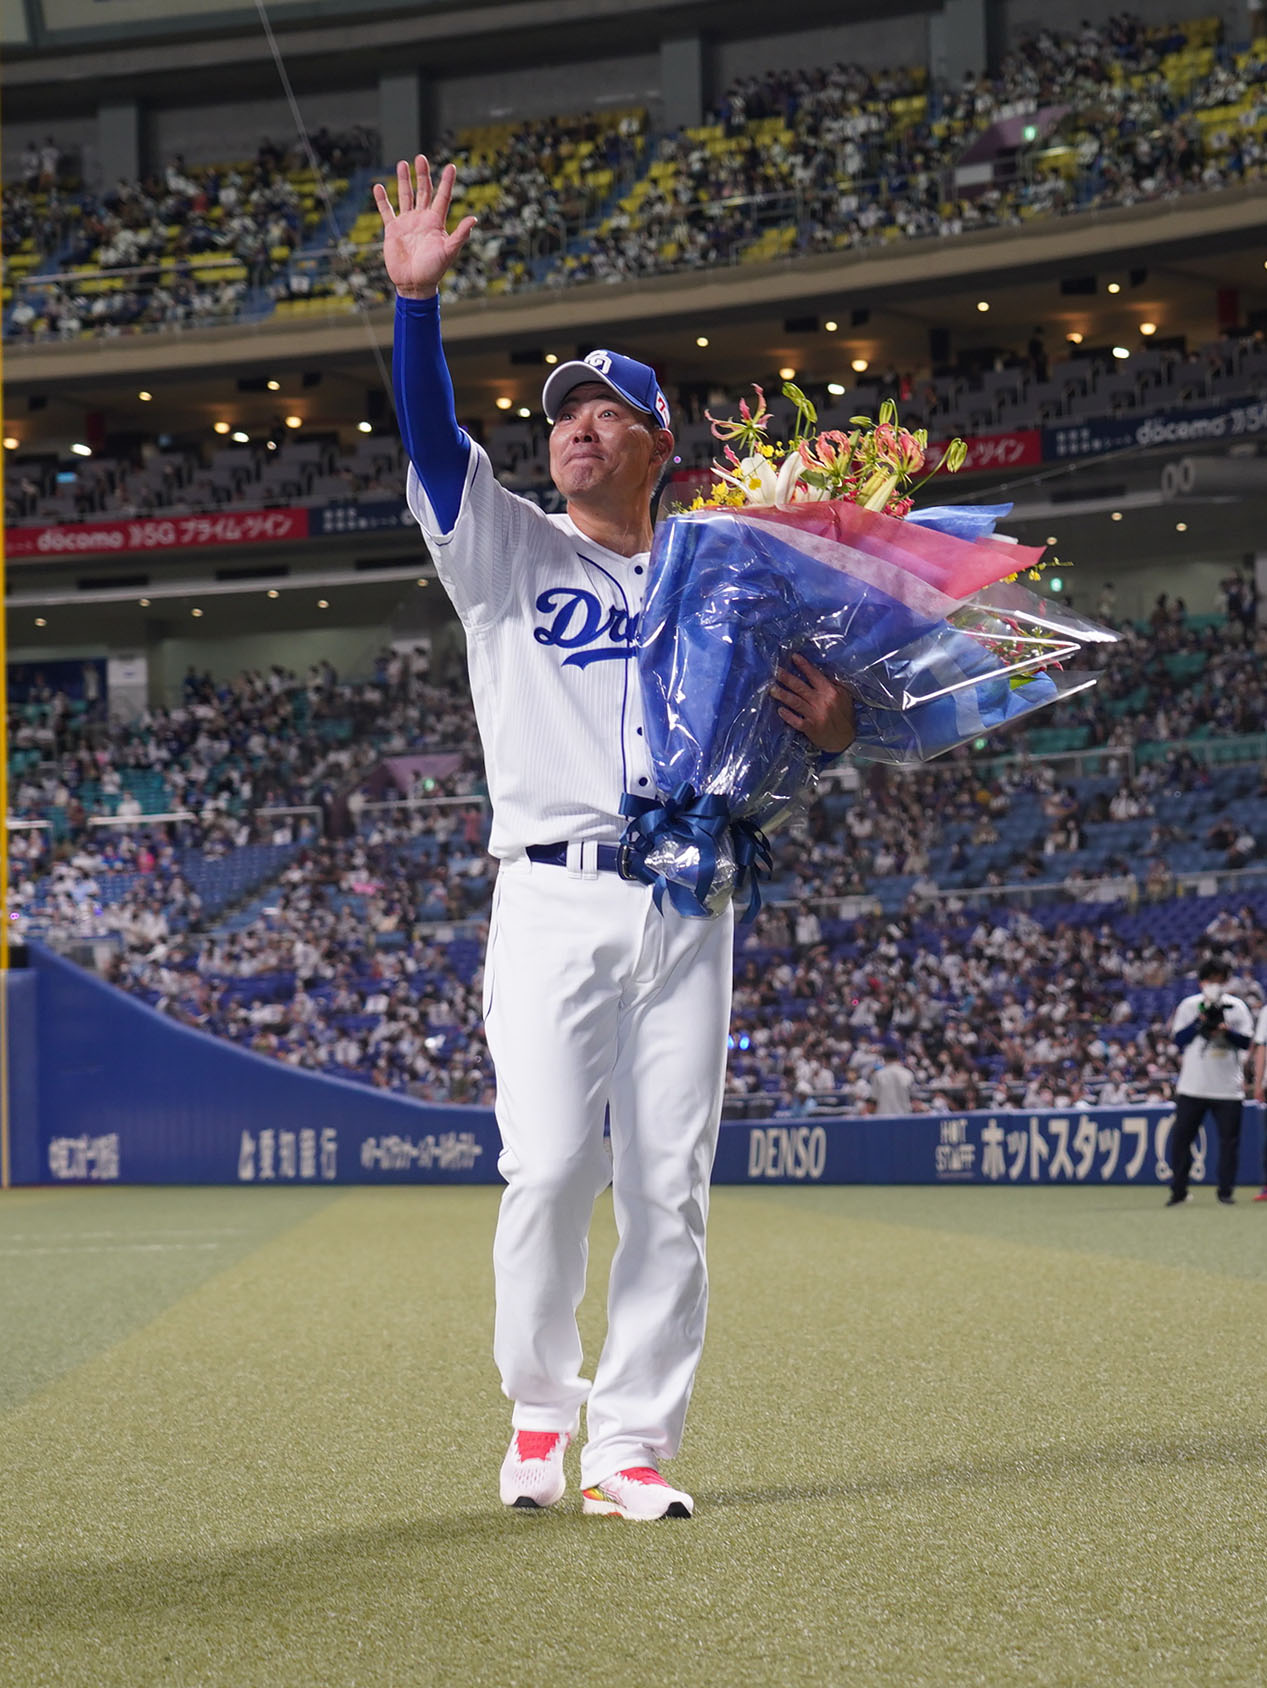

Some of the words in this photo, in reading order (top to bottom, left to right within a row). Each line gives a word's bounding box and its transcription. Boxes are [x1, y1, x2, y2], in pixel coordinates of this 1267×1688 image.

[940, 1119, 968, 1145] HOT
[980, 1114, 1149, 1181] ホットスタッフ
[748, 1127, 827, 1179] DENSO
[935, 1144, 976, 1171] STAFF
